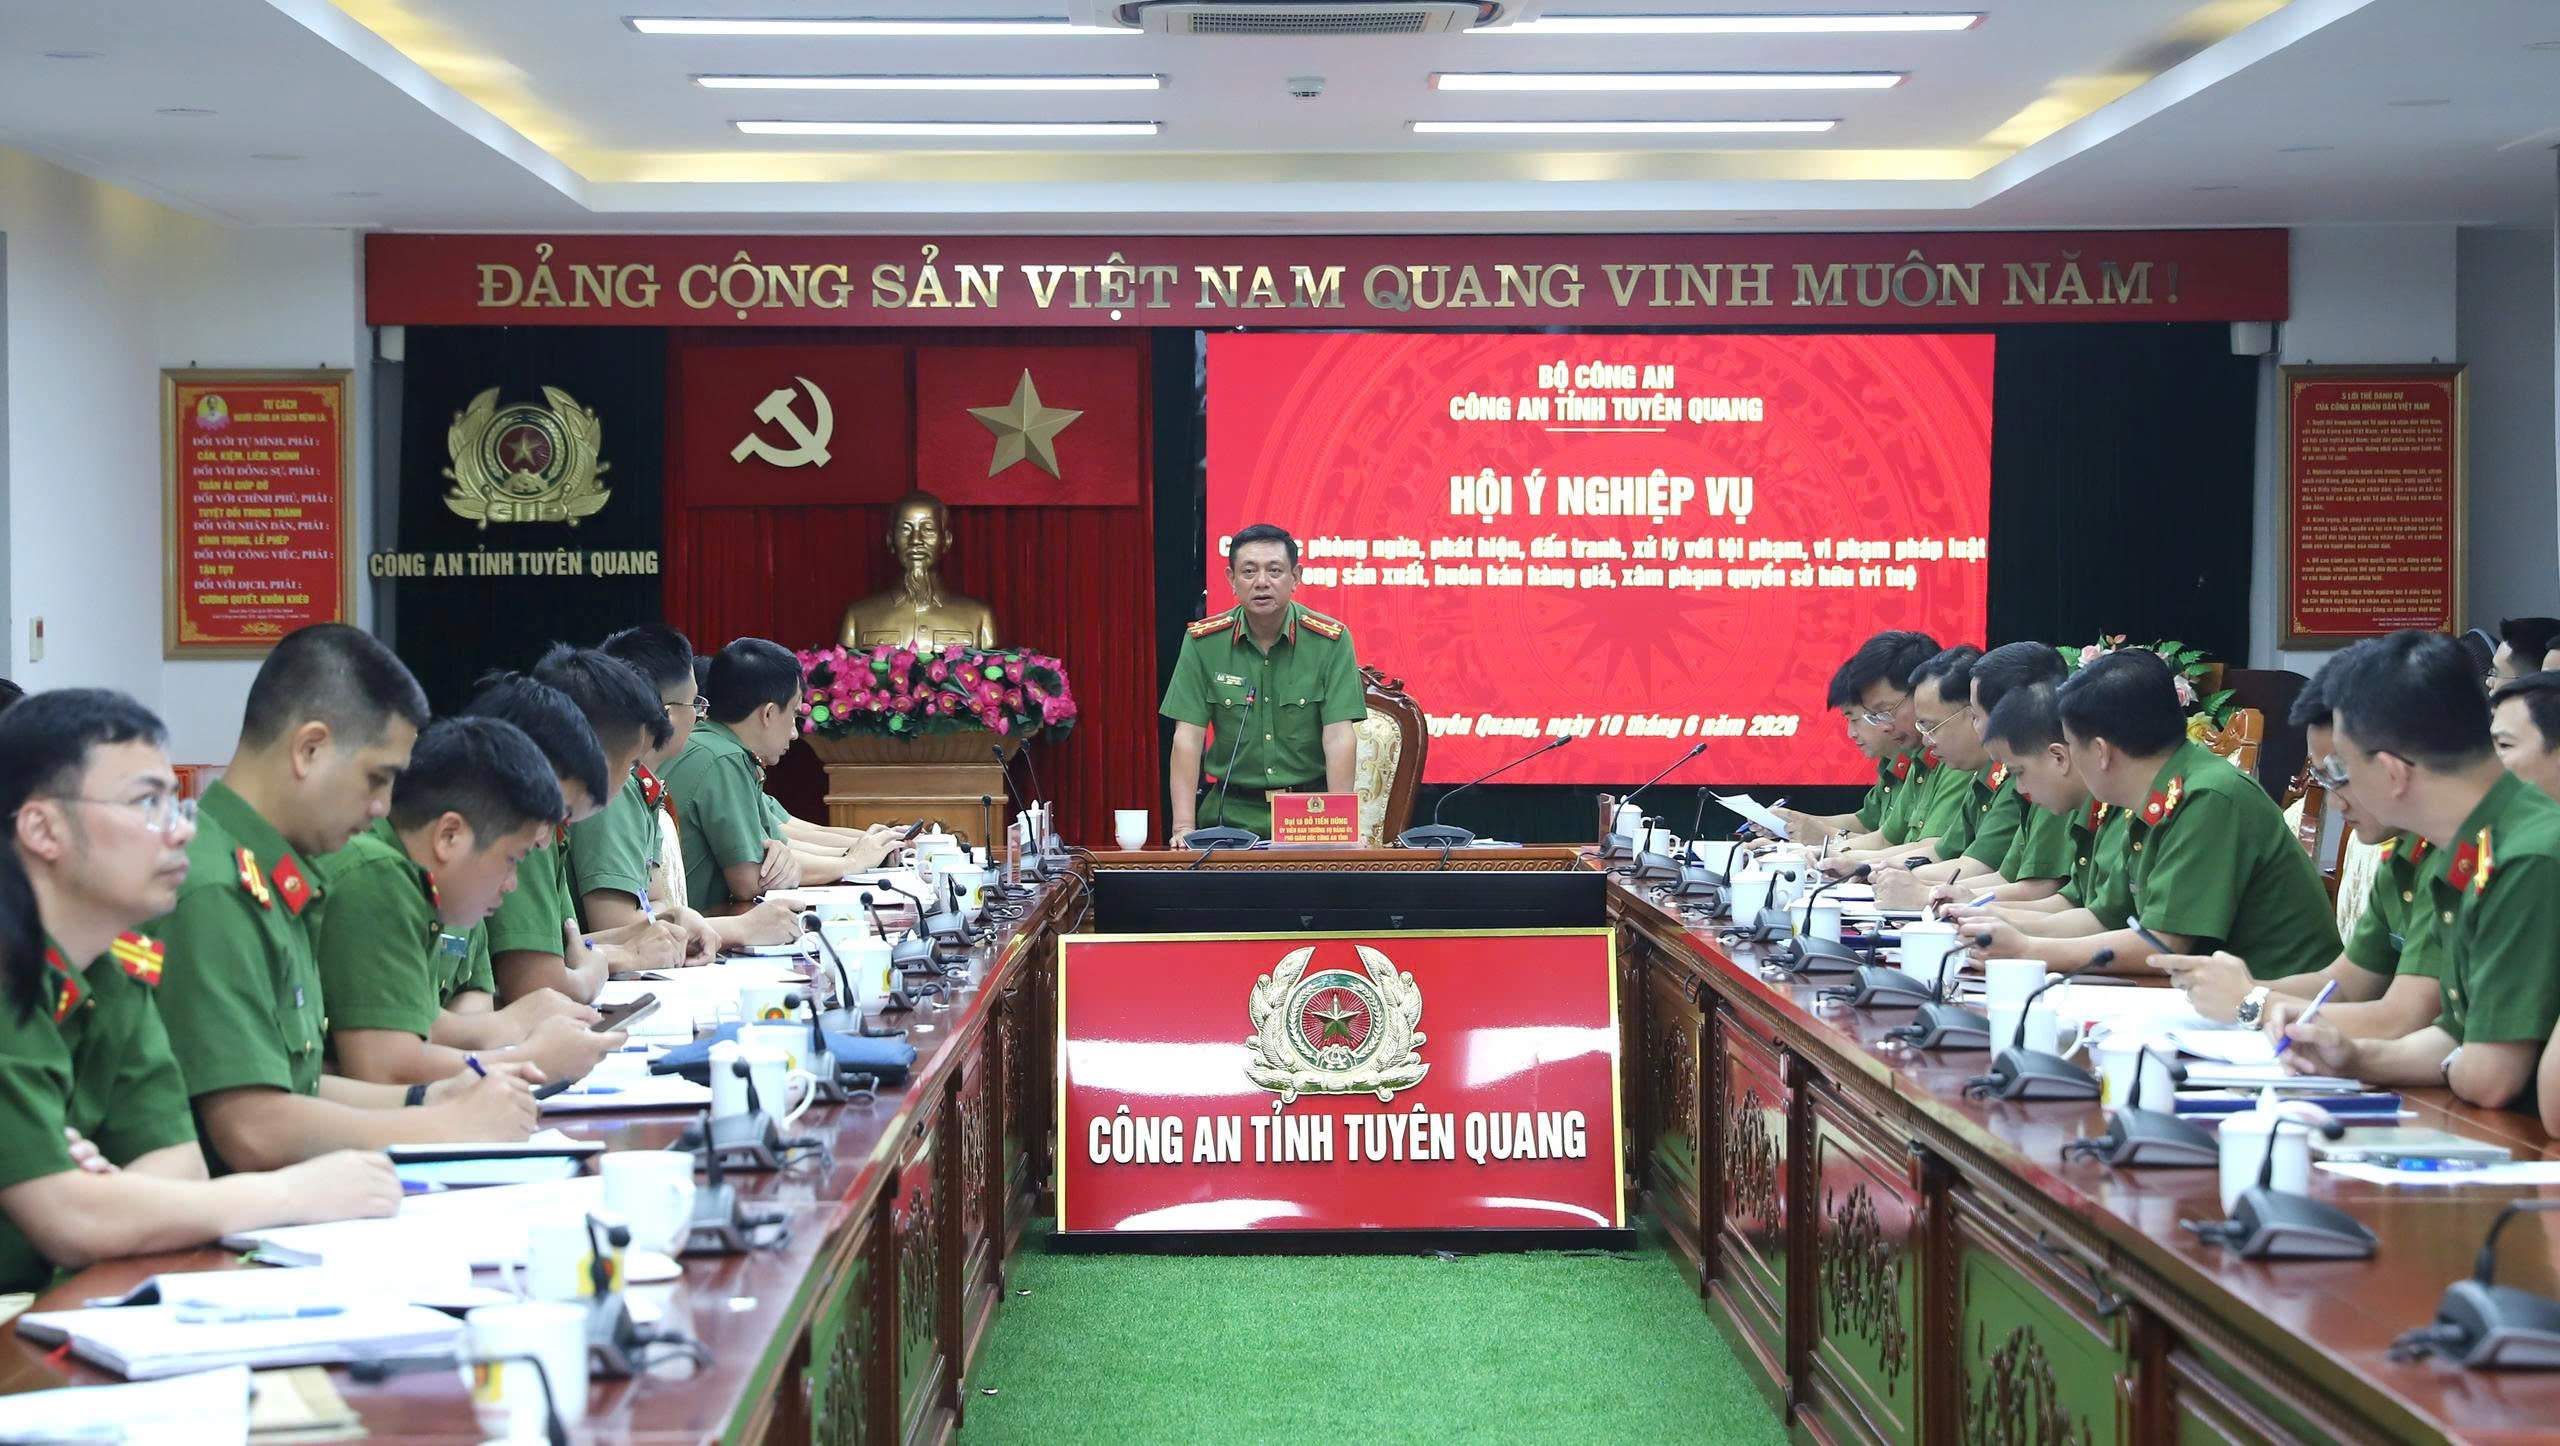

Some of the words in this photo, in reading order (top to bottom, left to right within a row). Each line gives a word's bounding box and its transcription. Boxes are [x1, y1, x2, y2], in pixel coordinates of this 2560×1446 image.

[479, 243, 660, 307] ĐẢNG
[679, 251, 854, 319] CỘNG
[872, 244, 1004, 308] SẢN
[1021, 252, 1177, 321] VIỆT
[1195, 266, 1346, 308] NAM
[1363, 264, 1585, 312] QUANG
[1601, 264, 1773, 306] VINH
[1792, 251, 1984, 306] MUÔN
[2003, 249, 2155, 305] NĂM
[2166, 264, 2180, 305] !
[1539, 361, 1569, 392] BỘ
[1574, 360, 1637, 390] CÔNG
[1642, 365, 1674, 389] AN
[1450, 391, 1511, 420] CÔNG
[1517, 397, 1549, 420] AN
[1554, 392, 1606, 421] TỈNH
[1612, 392, 1682, 421] TUYÊN
[1688, 397, 1763, 424] QUANG
[1451, 468, 1512, 523] HỘI
[1523, 468, 1546, 515] Ý
[1558, 469, 1694, 524] NGHIỆP
[1705, 477, 1753, 524] VỤ
[371, 548, 426, 577] CÔNG
[433, 553, 463, 576] AN
[468, 545, 514, 576] TỈNH
[518, 547, 582, 576] TUYÊN
[591, 551, 658, 577] QUANG
[1308, 536, 1367, 563] phòng
[1372, 536, 1425, 563] ngừa,
[1430, 536, 1473, 560] phát
[1478, 536, 1525, 562] hiện,
[1531, 534, 1566, 558] đấu
[1571, 537, 1627, 560] tranh,
[1632, 535, 1657, 558] xử
[1662, 537, 1680, 561] lý
[1684, 537, 1713, 558] với
[1718, 537, 1744, 563] tội
[1749, 538, 1808, 563] phạm,
[1813, 538, 1831, 558] vi
[1836, 538, 1890, 563] phạm
[1896, 537, 1943, 561] pháp
[1948, 537, 1986, 563] luật
[1301, 568, 1337, 587] ong
[1342, 562, 1377, 585] sản
[1382, 562, 1429, 587] xuất,
[1435, 564, 1482, 585] buôn
[1487, 564, 1523, 586] bán
[1528, 564, 1575, 588] hàng
[1580, 563, 1616, 588] giả,
[1622, 565, 1663, 586] xâm
[1669, 566, 1722, 590] phạm
[1727, 562, 1785, 589] quyền
[1790, 563, 1814, 586] sở
[1819, 566, 1854, 587] hữu
[1859, 565, 1881, 587] trí
[1886, 565, 1917, 590] tuệ
[1424, 713, 1473, 737] uyên
[1475, 714, 1540, 738] Quang,
[1545, 714, 1596, 740] ngày
[1599, 715, 1624, 736] 10
[1625, 714, 1682, 738] tháng
[1683, 715, 1699, 736] 6
[1700, 715, 1746, 736] năm
[1090, 1106, 1184, 1163] CÔNG
[1193, 1116, 1241, 1162] AN
[1251, 1098, 1333, 1161] TỈNH
[1344, 1104, 1454, 1160] TUYÊN
[1466, 1111, 1586, 1164] QUANG
